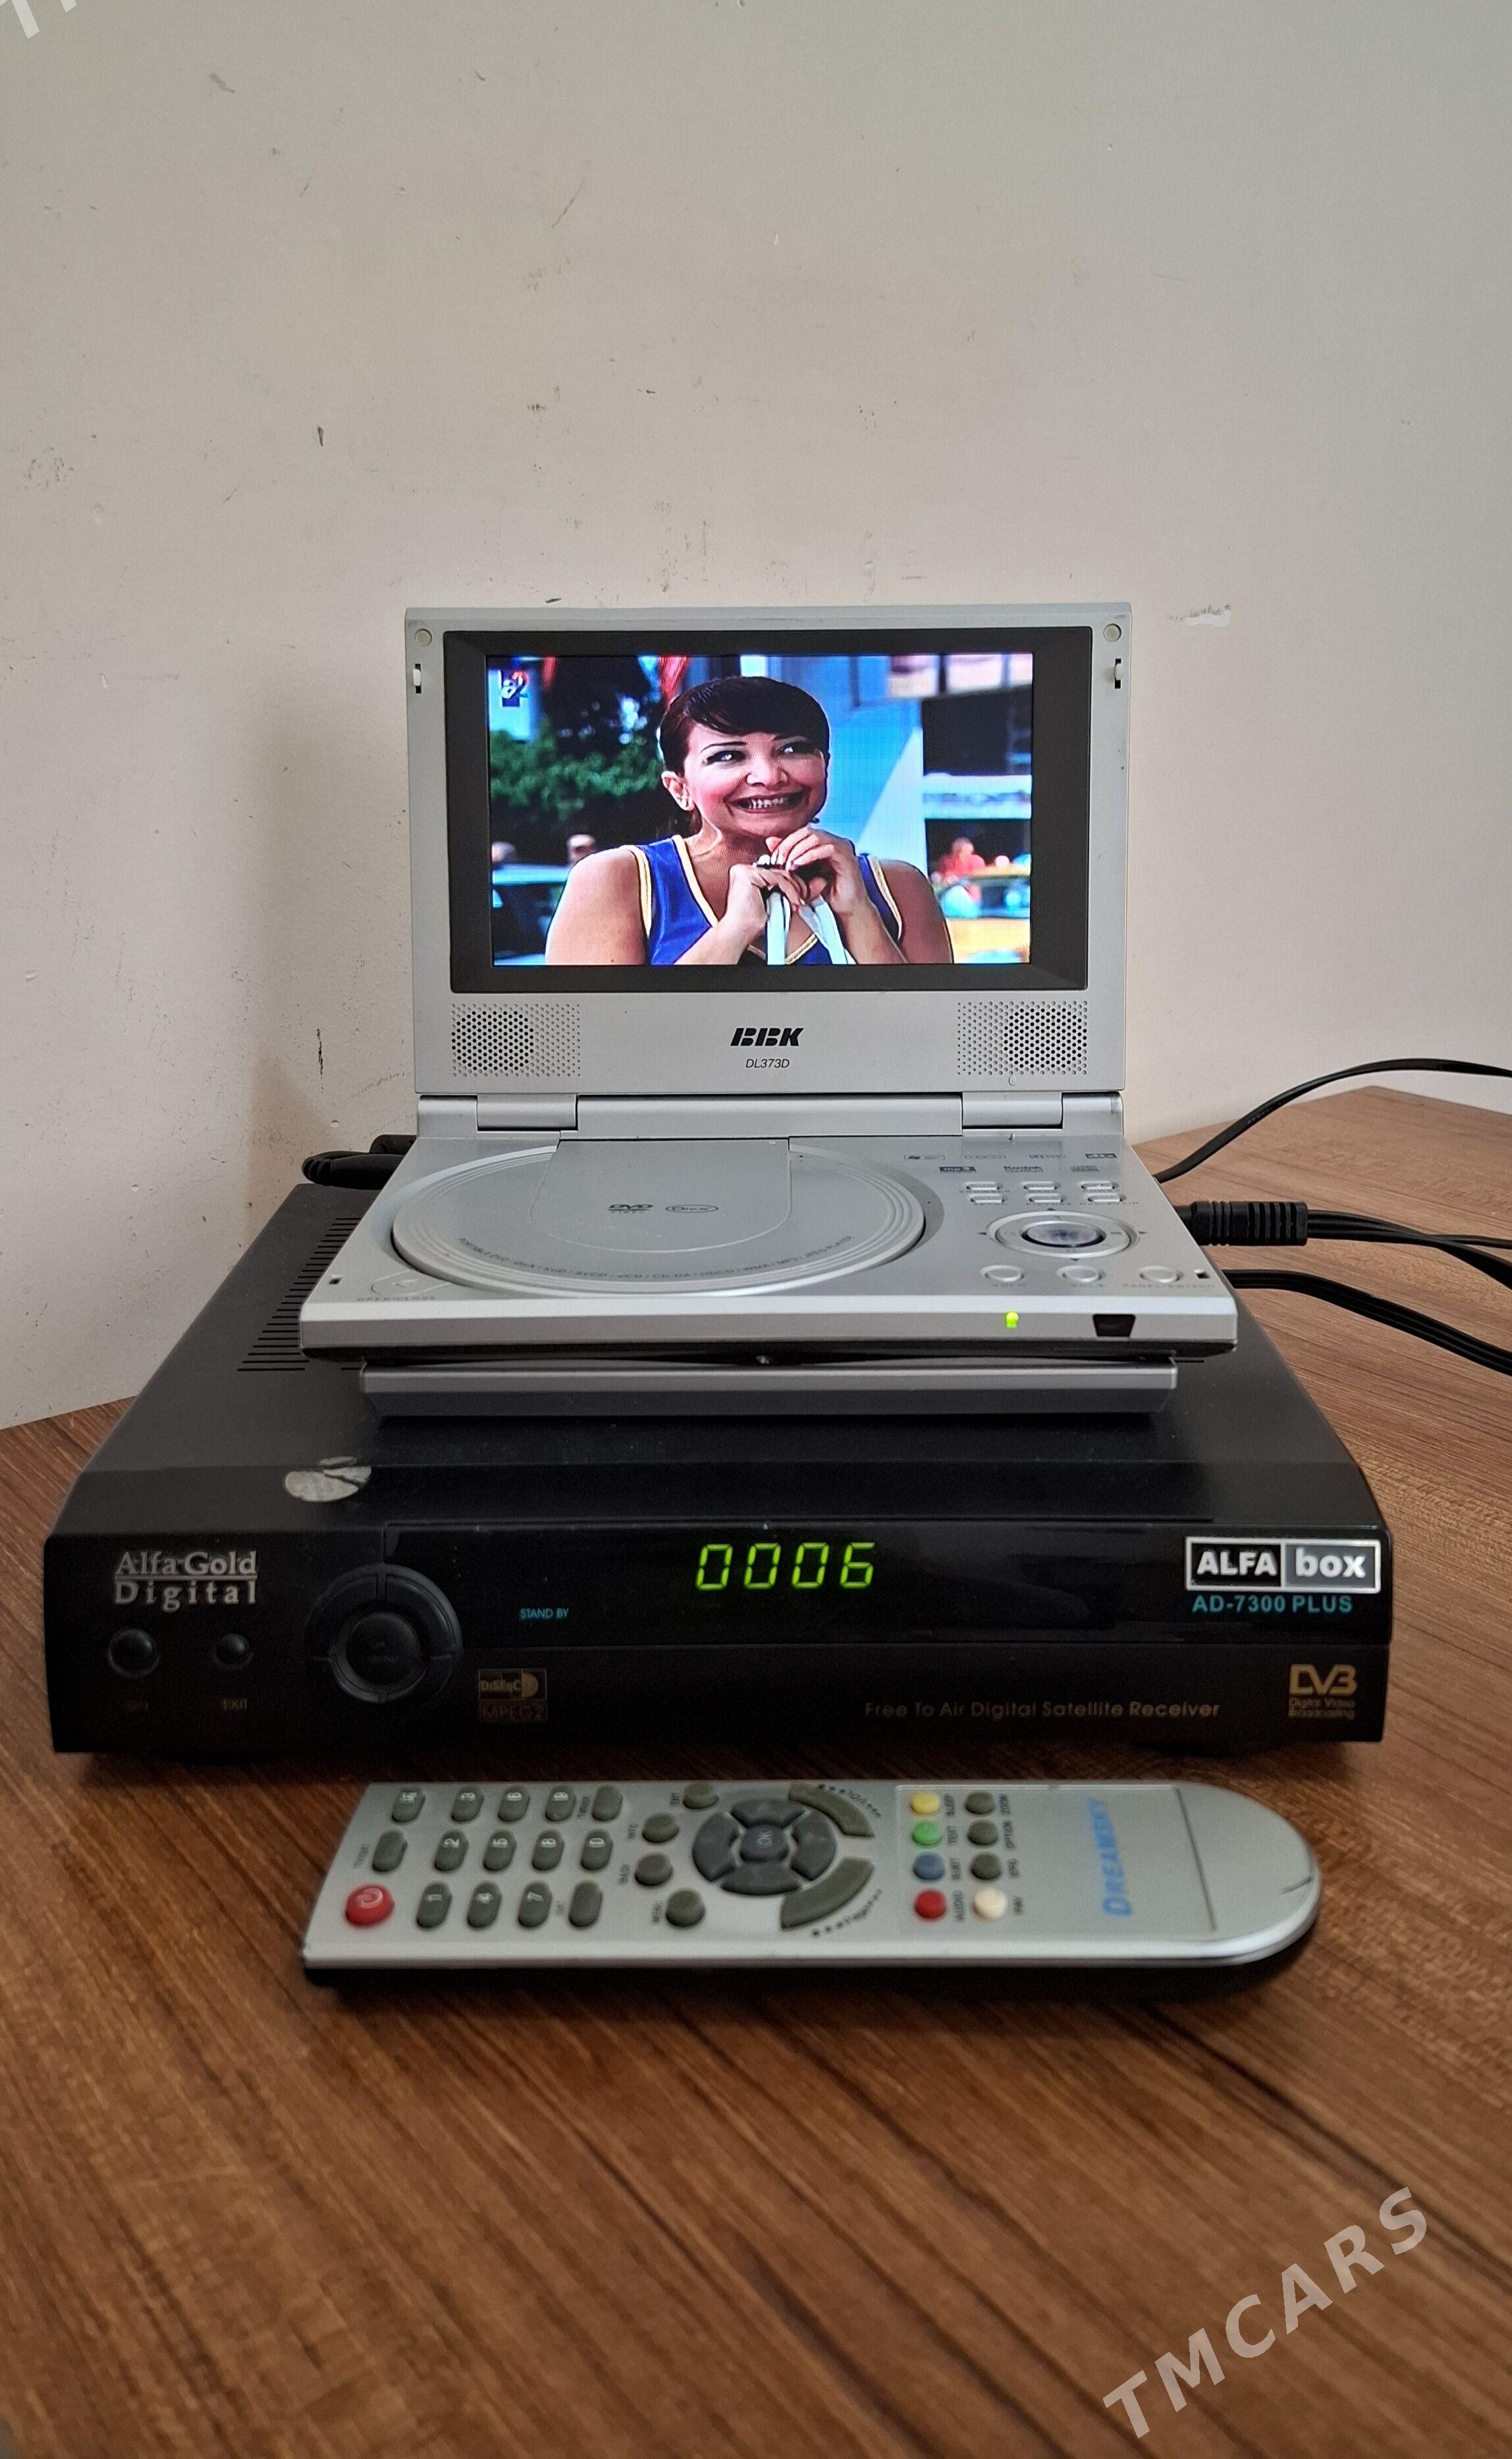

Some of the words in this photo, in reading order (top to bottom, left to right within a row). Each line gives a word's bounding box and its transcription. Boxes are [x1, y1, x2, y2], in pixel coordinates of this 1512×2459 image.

[730, 1027, 804, 1046] BBK
[745, 1058, 790, 1068] DL373D
[695, 1542, 876, 1590] 0006
[1195, 1550, 1278, 1577] ALFA
[1295, 1548, 1366, 1578] box
[115, 1580, 257, 1612] Digital
[1192, 1595, 1286, 1613] AD-7300
[1292, 1595, 1353, 1613] PLUS
[520, 1608, 554, 1619] STAND
[556, 1608, 569, 1619] BY
[1289, 1663, 1358, 1696] DVB
[865, 1702, 907, 1717] Free
[914, 1702, 935, 1717] To
[939, 1702, 964, 1717] Air
[971, 1701, 1037, 1719] Digital
[1042, 1701, 1123, 1717] Satellite
[1130, 1701, 1220, 1717] Receiver
[445, 1838, 461, 1849] 2
[493, 1837, 509, 1849] 5
[541, 1837, 558, 1849] 8
